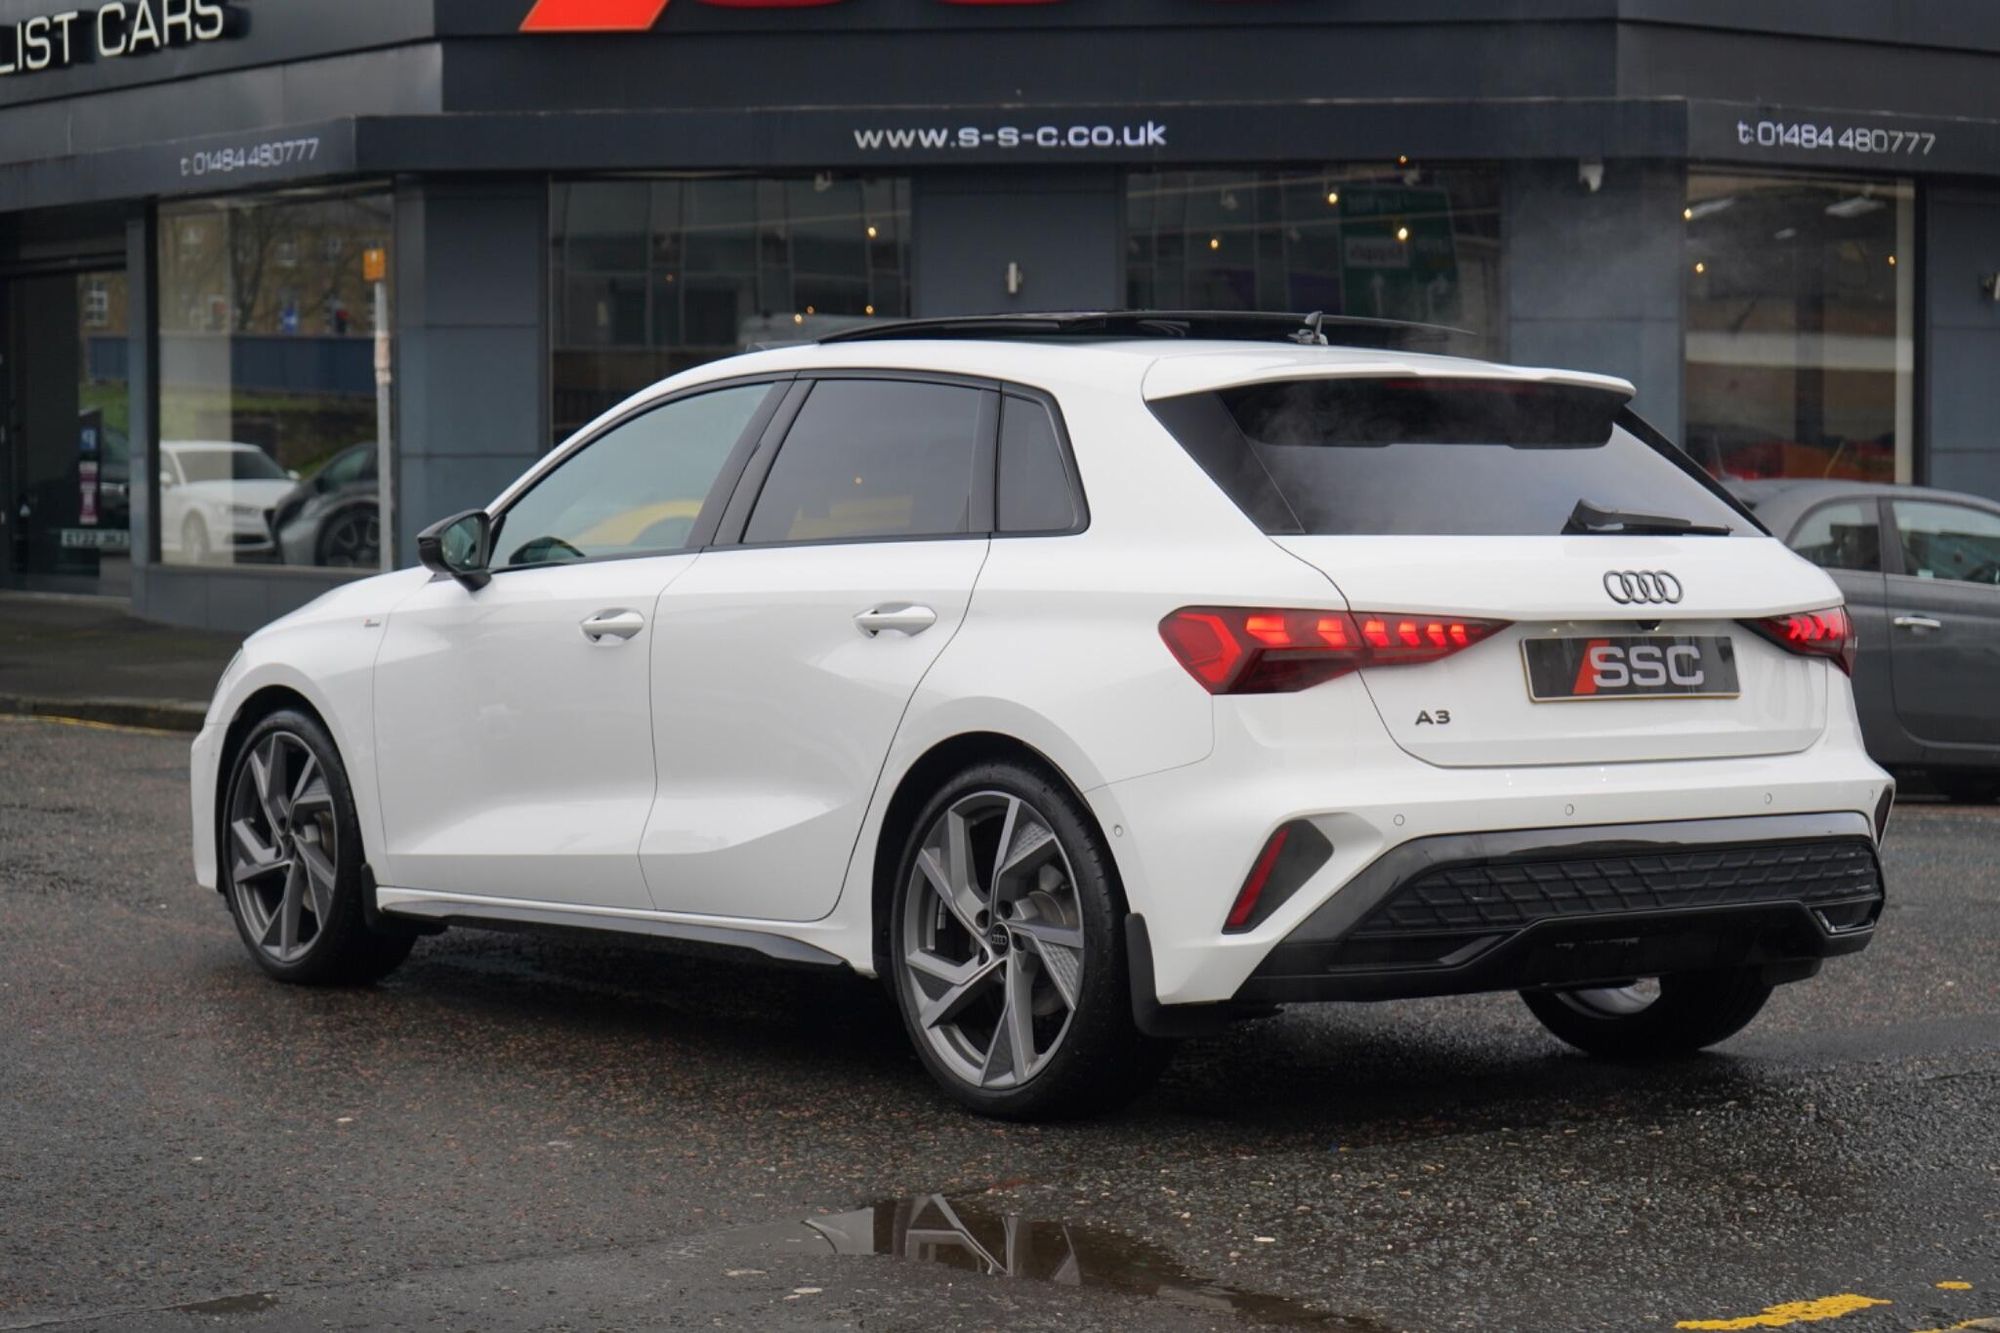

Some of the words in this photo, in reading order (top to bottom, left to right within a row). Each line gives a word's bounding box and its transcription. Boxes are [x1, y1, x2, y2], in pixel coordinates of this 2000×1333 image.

[0, 11, 78, 74] IST
[98, 0, 223, 56] CARS
[854, 121, 1167, 148] www.s-s-c.co.uk
[1590, 645, 1705, 688] SSC
[1415, 710, 1451, 725] A3
